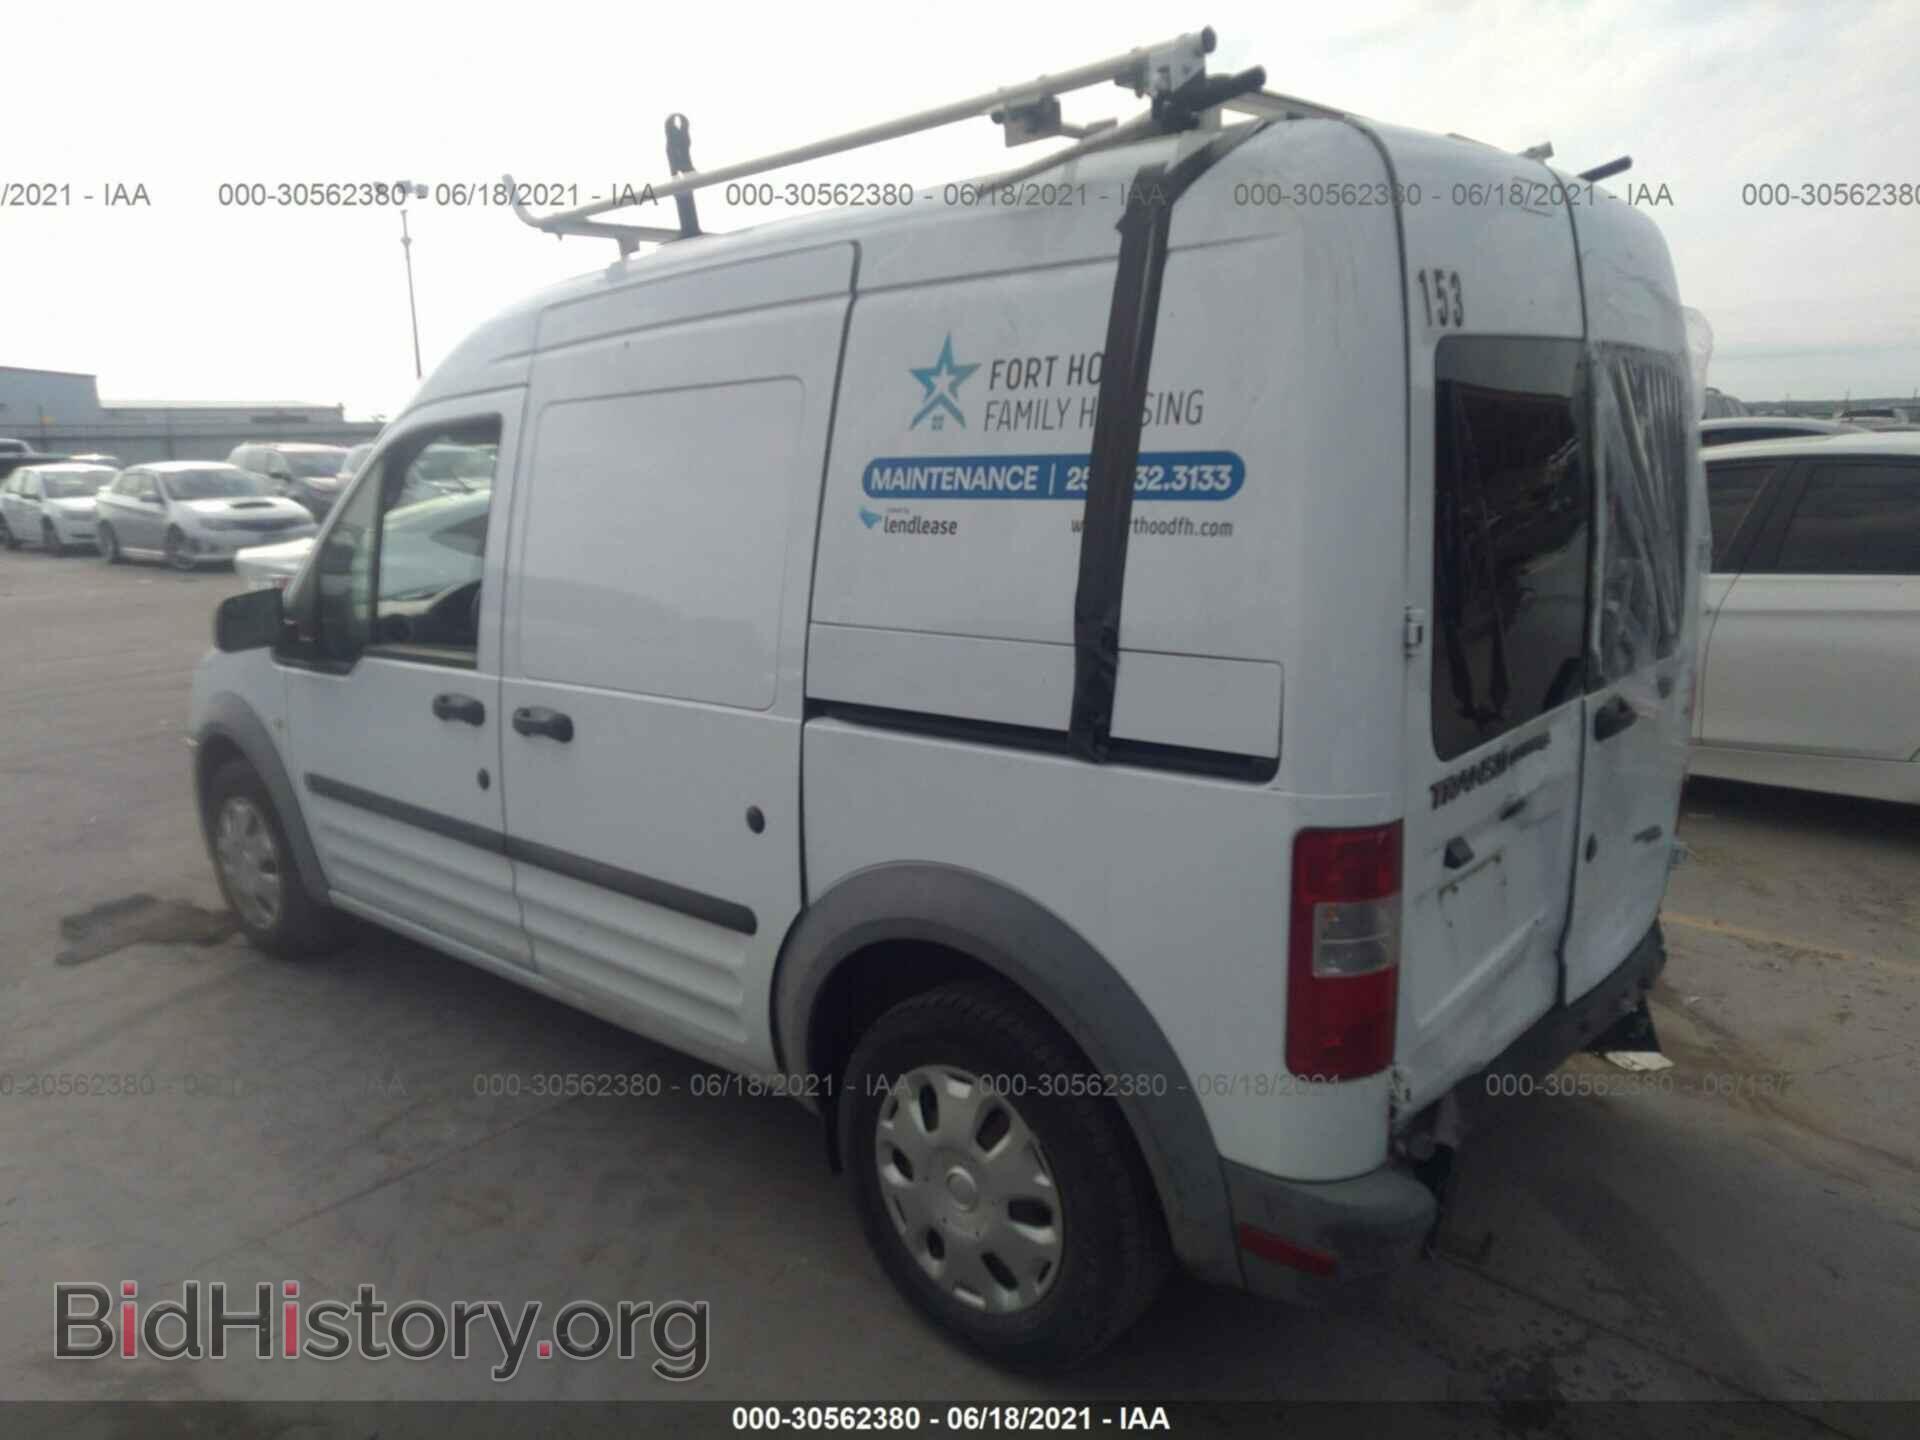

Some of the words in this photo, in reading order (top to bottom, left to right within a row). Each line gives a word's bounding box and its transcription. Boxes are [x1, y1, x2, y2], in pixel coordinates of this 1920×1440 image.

[1419, 268, 1464, 327] 153
[989, 355, 1058, 390] FORT
[984, 398, 1070, 432] FAMILY
[1079, 389, 1204, 429] HSING
[871, 465, 1038, 491] MAINTENANCE
[884, 515, 958, 535] lendlease
